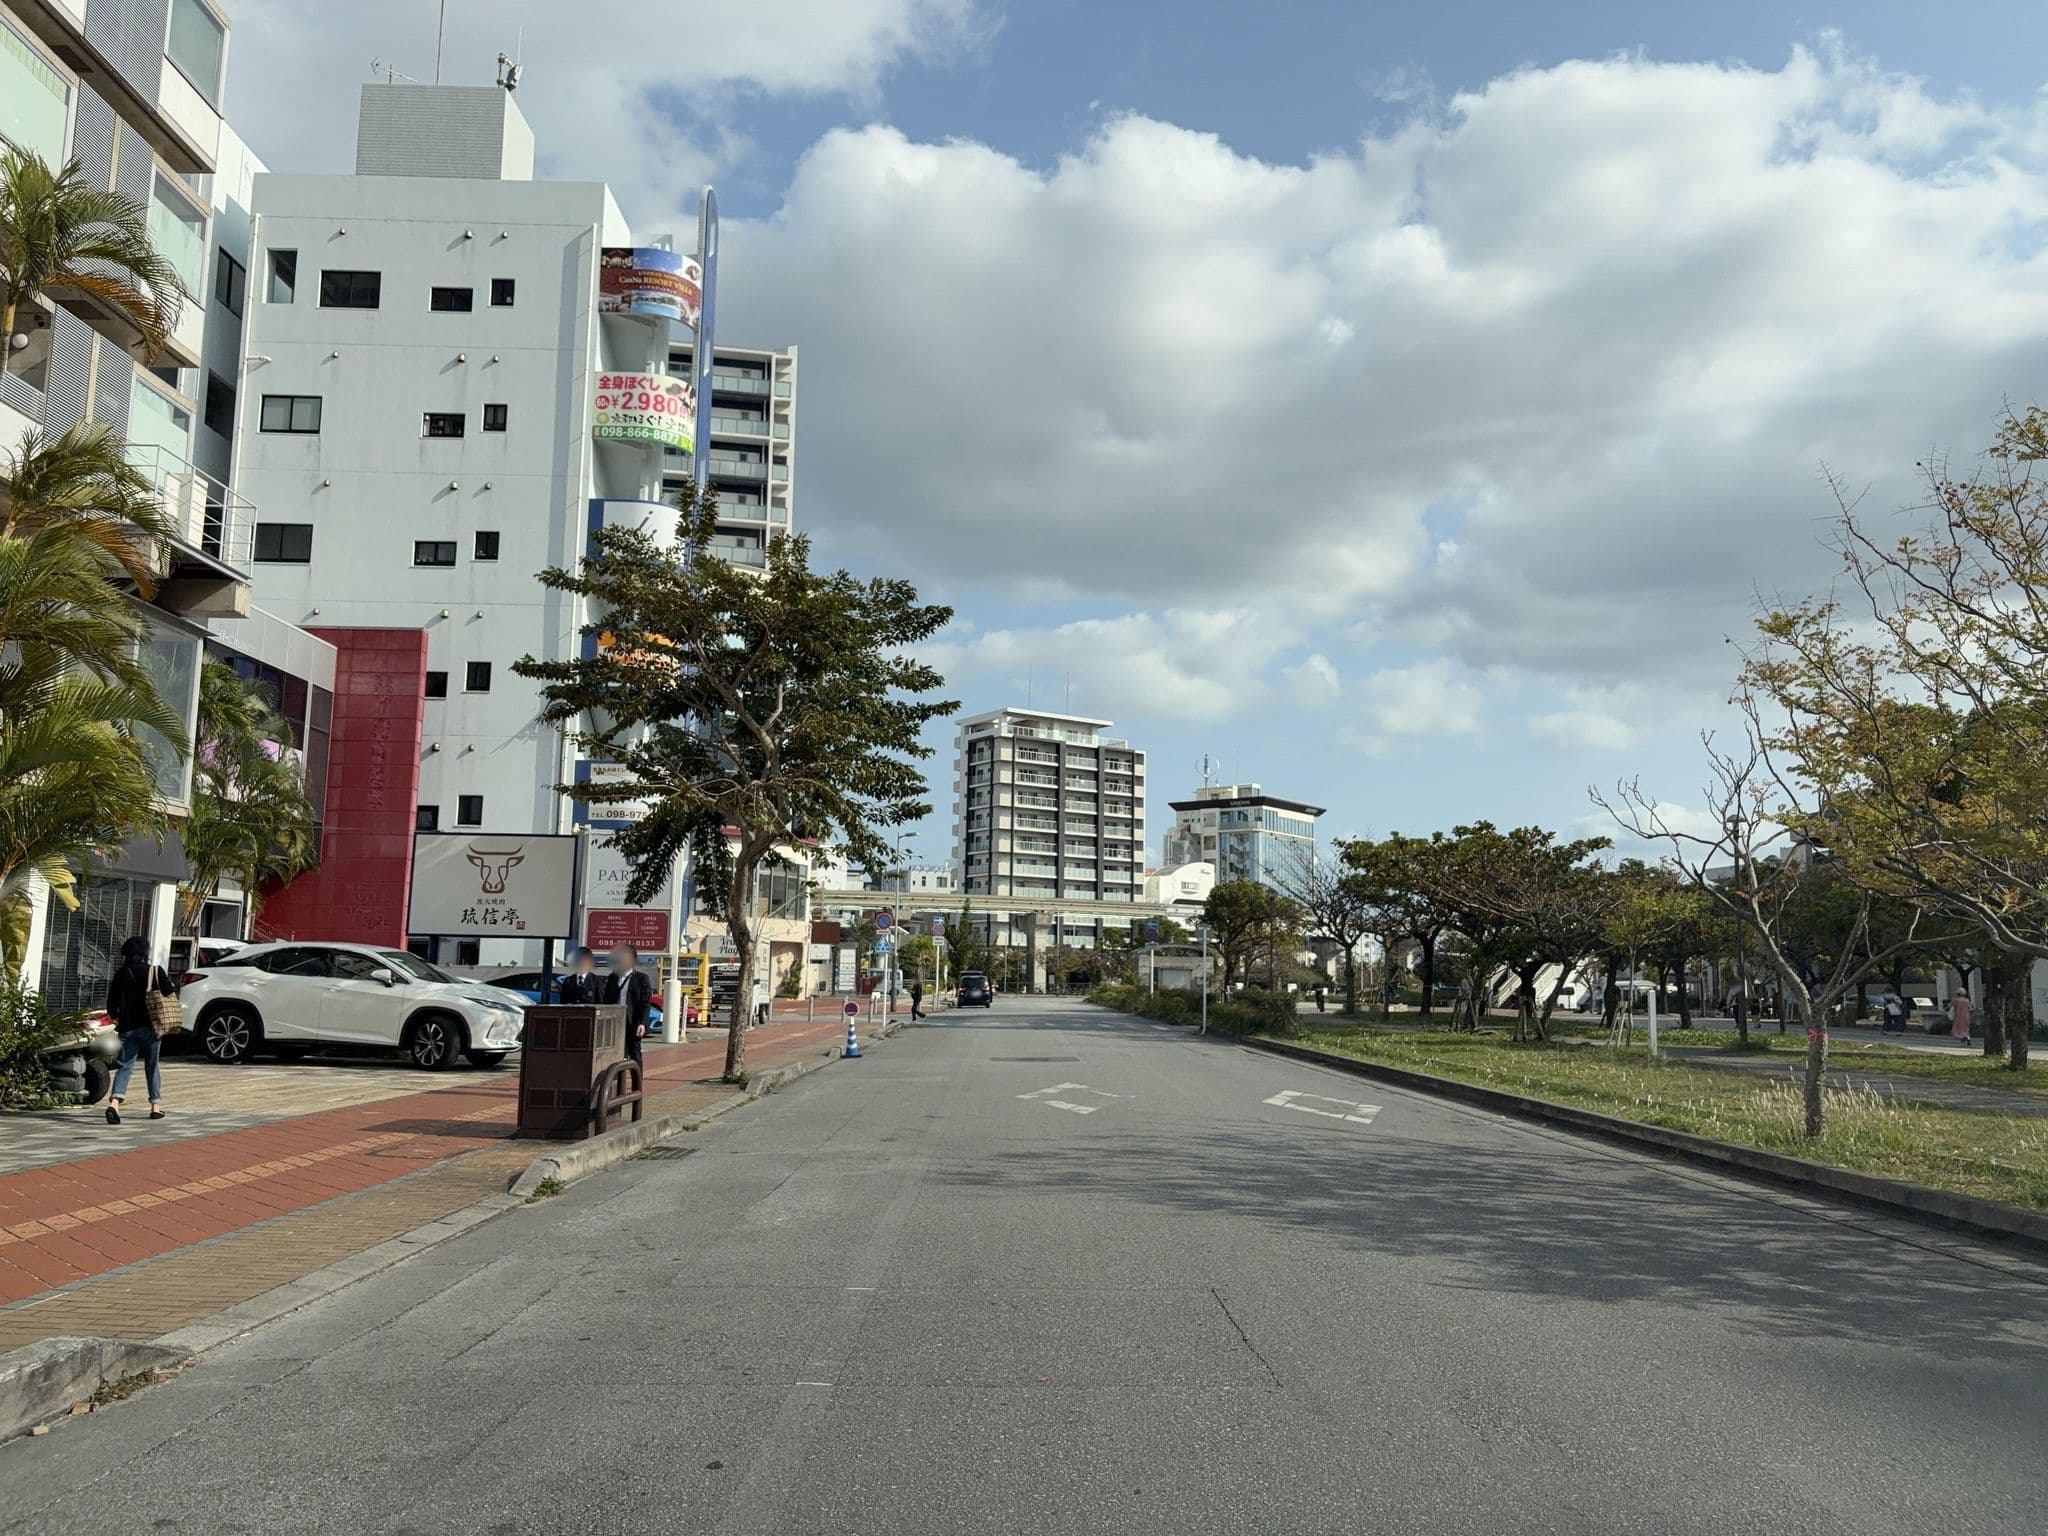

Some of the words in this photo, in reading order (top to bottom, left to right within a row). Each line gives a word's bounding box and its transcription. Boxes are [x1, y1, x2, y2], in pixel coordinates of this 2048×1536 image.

[643, 276, 672, 288] RESORT
[674, 282, 693, 296] VILLA
[598, 375, 660, 391] 全身ほぐし
[601, 427, 680, 444] 098-866-8877
[460, 907, 519, 926] 琉信亭
[598, 939, 656, 947] 098-1-0133
